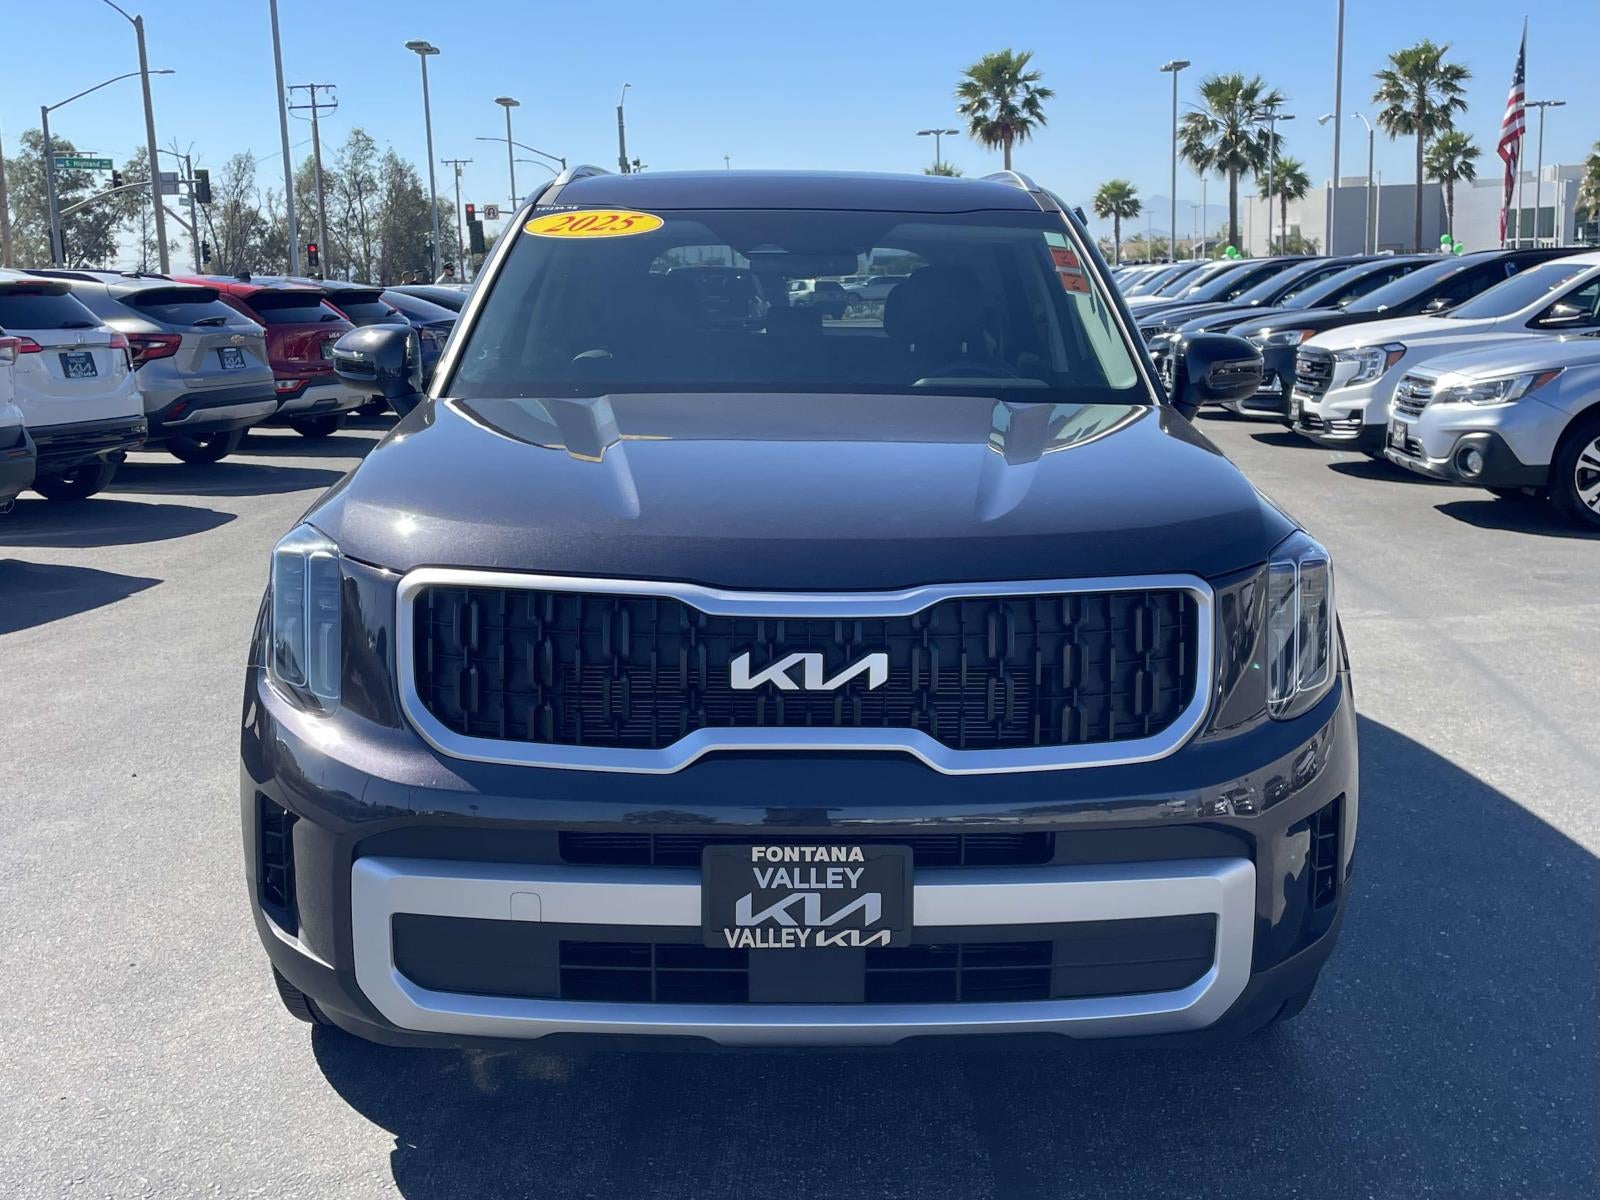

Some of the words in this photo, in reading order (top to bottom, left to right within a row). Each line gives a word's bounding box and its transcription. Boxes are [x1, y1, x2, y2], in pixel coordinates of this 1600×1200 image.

[543, 215, 644, 233] 2025
[69, 362, 92, 372] KIA
[731, 652, 888, 690] KIA
[752, 846, 864, 862] FONTANA
[753, 867, 864, 889] VALLEY
[736, 892, 882, 926] KIA
[724, 928, 812, 948] VALLEY
[815, 929, 891, 947] KIA
